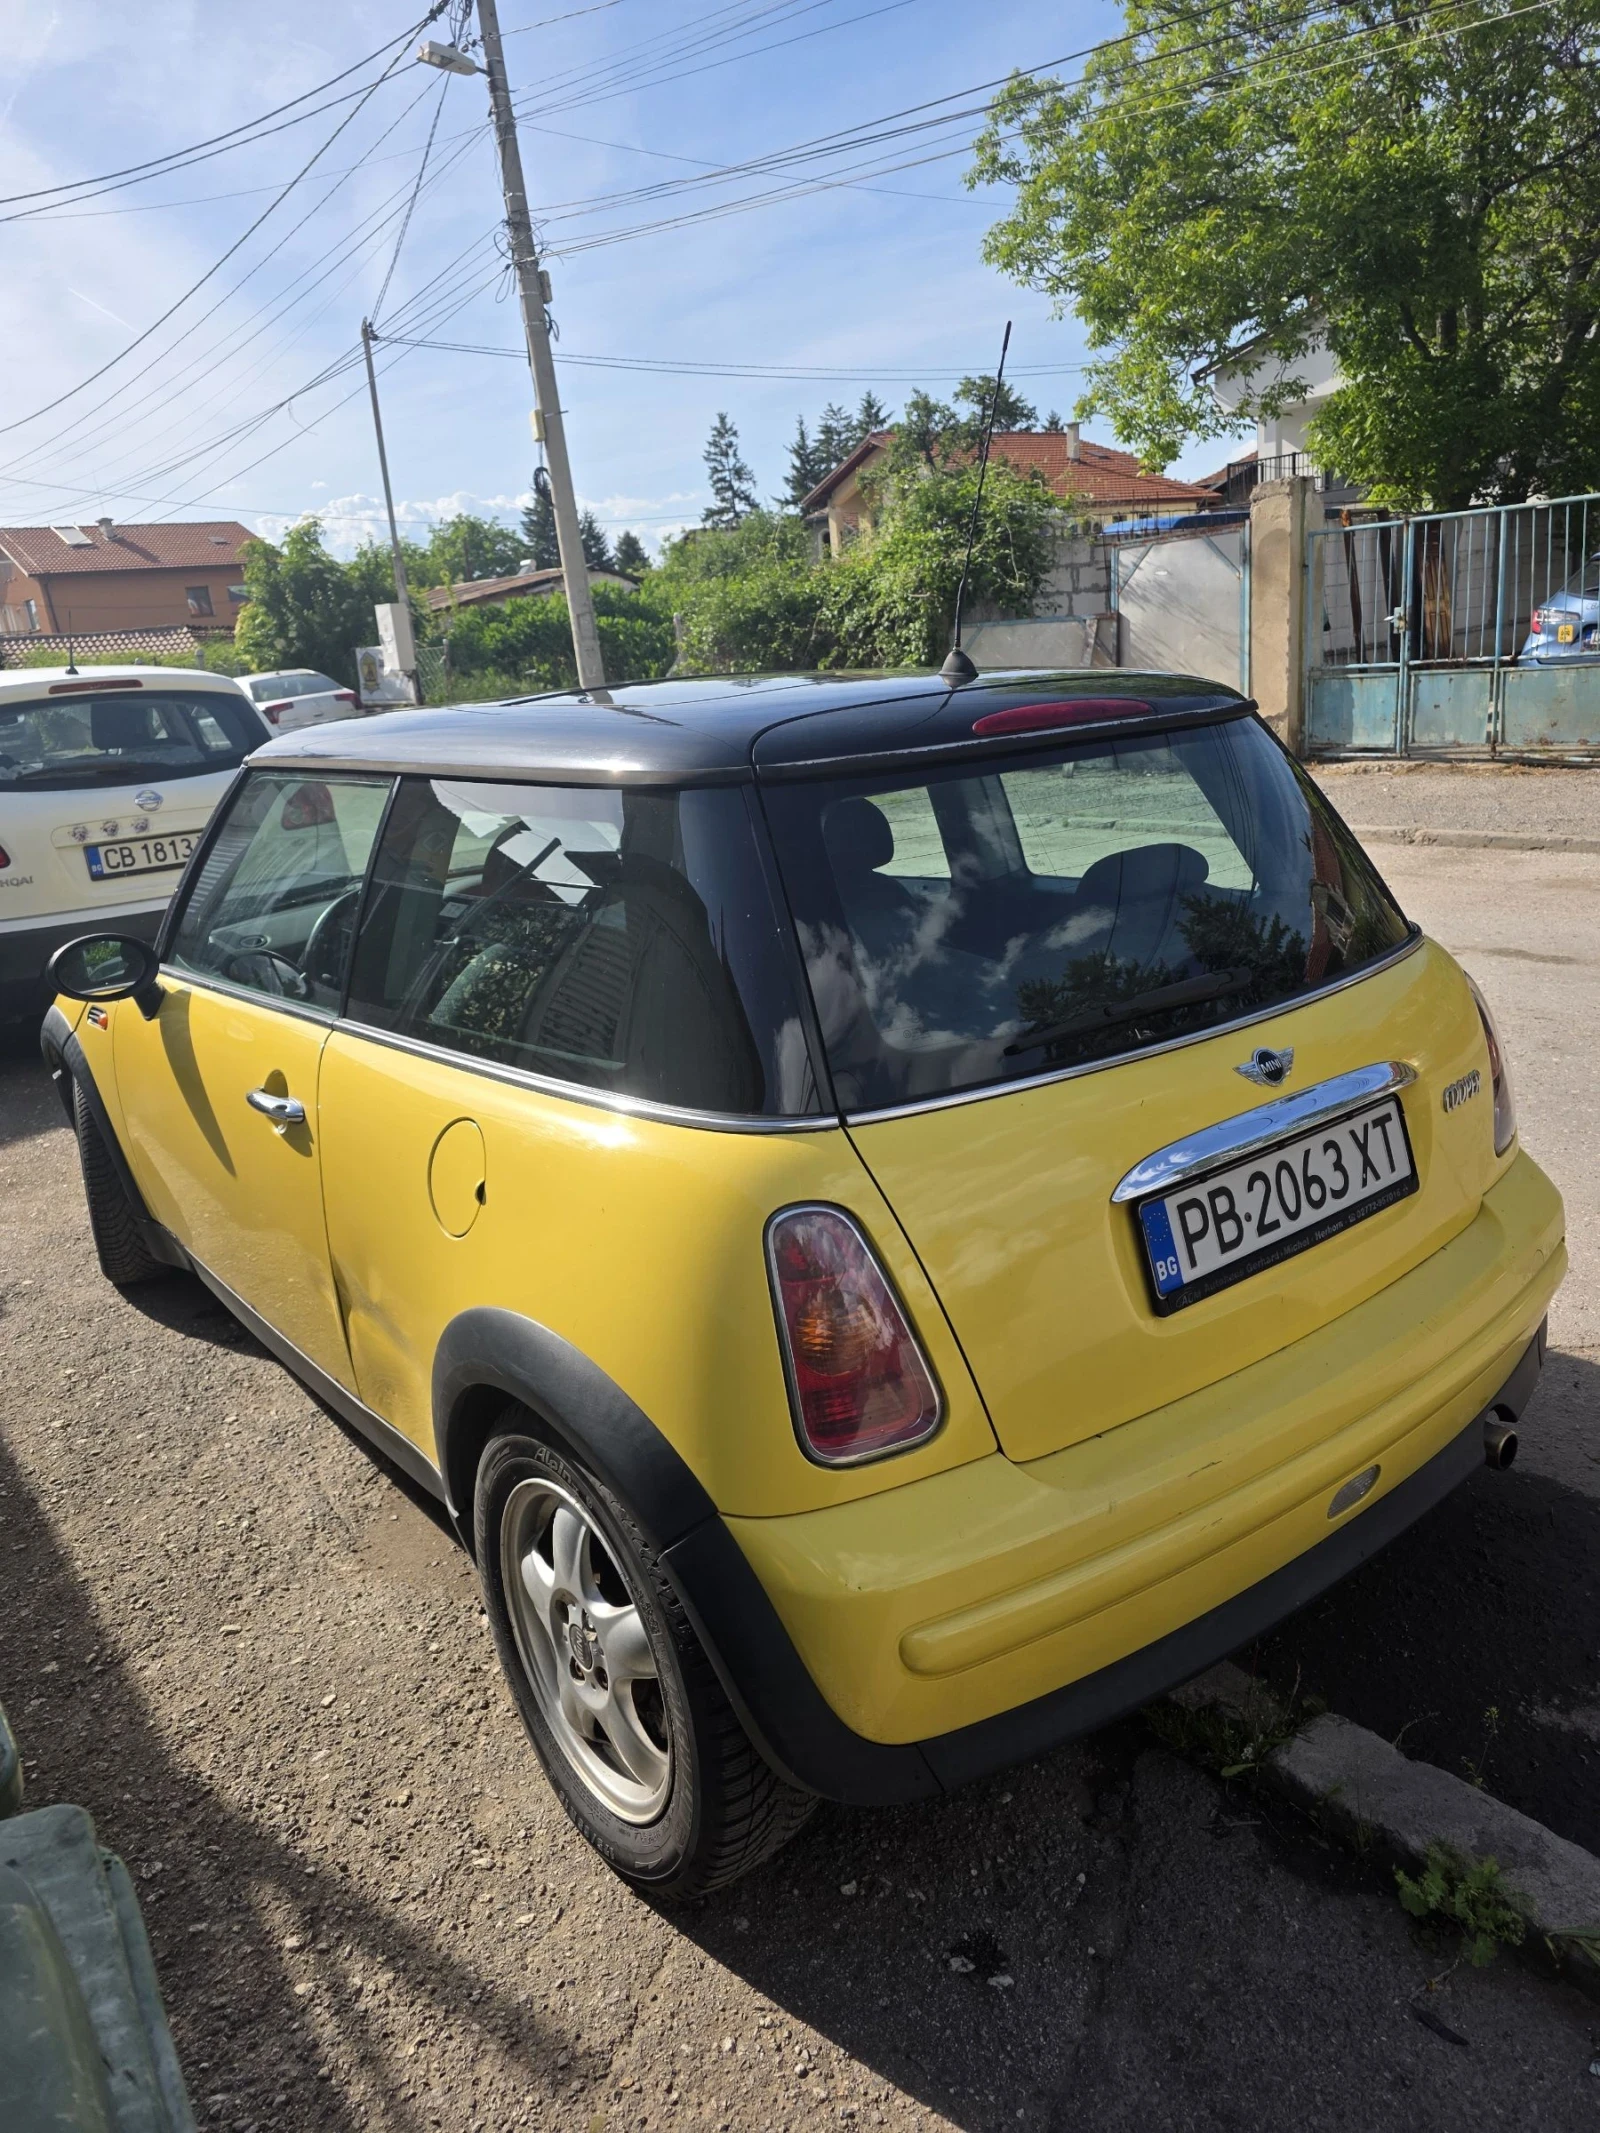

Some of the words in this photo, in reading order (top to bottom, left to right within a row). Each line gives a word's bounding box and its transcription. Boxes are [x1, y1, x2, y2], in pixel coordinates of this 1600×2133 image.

[103, 846, 136, 869] CB
[141, 838, 194, 864] 1813
[1260, 1059, 1282, 1074] MINI
[1443, 1069, 1480, 1113] COOPER
[1176, 1186, 1244, 1270] PB
[1247, 1139, 1350, 1238] 2063
[1349, 1112, 1396, 1189] XT
[1156, 1256, 1178, 1281] BG
